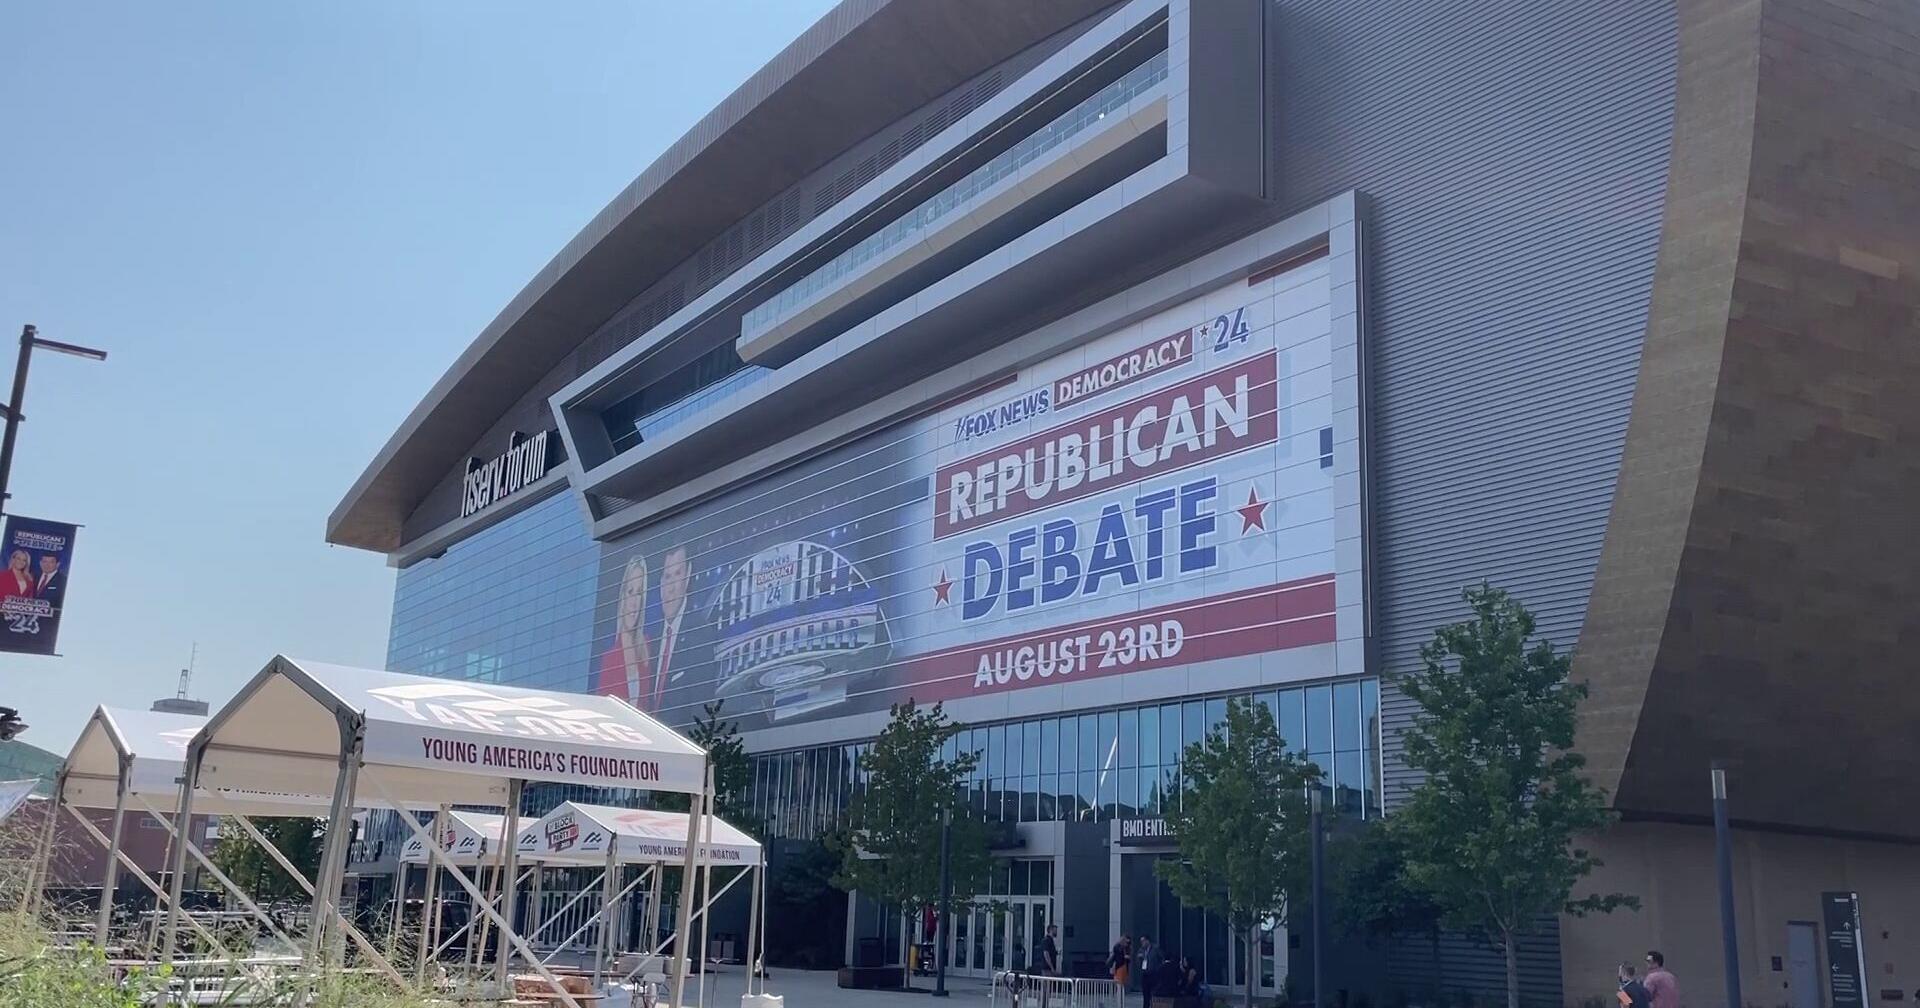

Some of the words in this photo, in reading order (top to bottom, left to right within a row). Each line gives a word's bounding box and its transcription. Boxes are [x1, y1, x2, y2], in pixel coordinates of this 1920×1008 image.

[966, 410, 997, 440] FOX
[1000, 389, 1049, 424] NEWS
[1057, 335, 1188, 404] DEMOCRACY
[1213, 306, 1249, 352] 24
[947, 373, 1249, 525] REPUBLICAN
[961, 475, 1218, 622] DEBATE
[1, 603, 50, 615] DEMOCRACY
[973, 633, 1092, 689] AUGUST
[1098, 619, 1185, 669] 23RD
[422, 737, 477, 764] YOUNG
[482, 745, 566, 773] AMERICA'S
[570, 753, 660, 781] FOUNDATION
[639, 844, 662, 856] YOUNG
[1122, 819, 1143, 837] BMO
